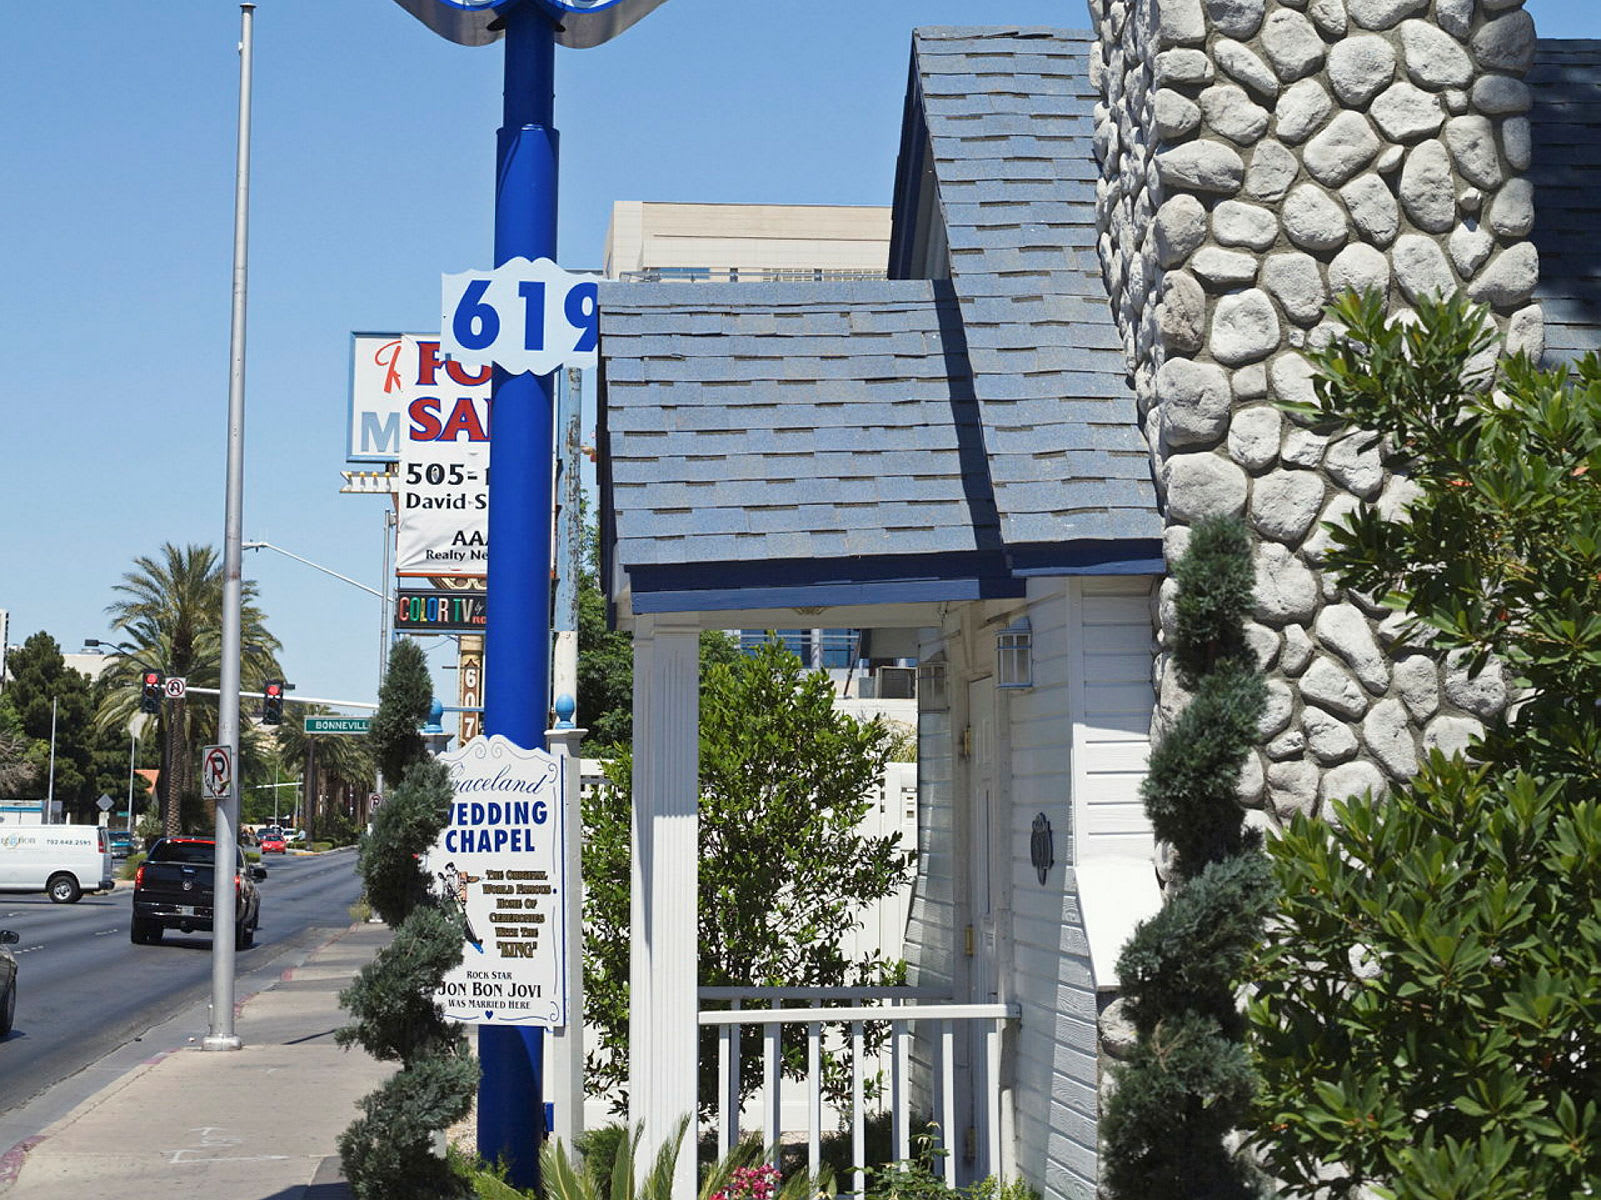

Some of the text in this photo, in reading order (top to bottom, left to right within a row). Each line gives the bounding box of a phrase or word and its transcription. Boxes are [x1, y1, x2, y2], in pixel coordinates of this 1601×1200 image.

[453, 279, 599, 352] 619
[408, 396, 492, 442] SA
[361, 411, 401, 453] M
[406, 492, 488, 510] David S
[425, 549, 489, 562] Realty Ne
[399, 596, 449, 623] COLOR
[453, 598, 474, 624] TV
[315, 720, 371, 730] BONNEVILL
[445, 829, 535, 853] CHAPEL
[438, 981, 541, 998] JON BON JOVI
[469, 999, 506, 1009] MARRIED
[508, 1001, 531, 1010] HERE
